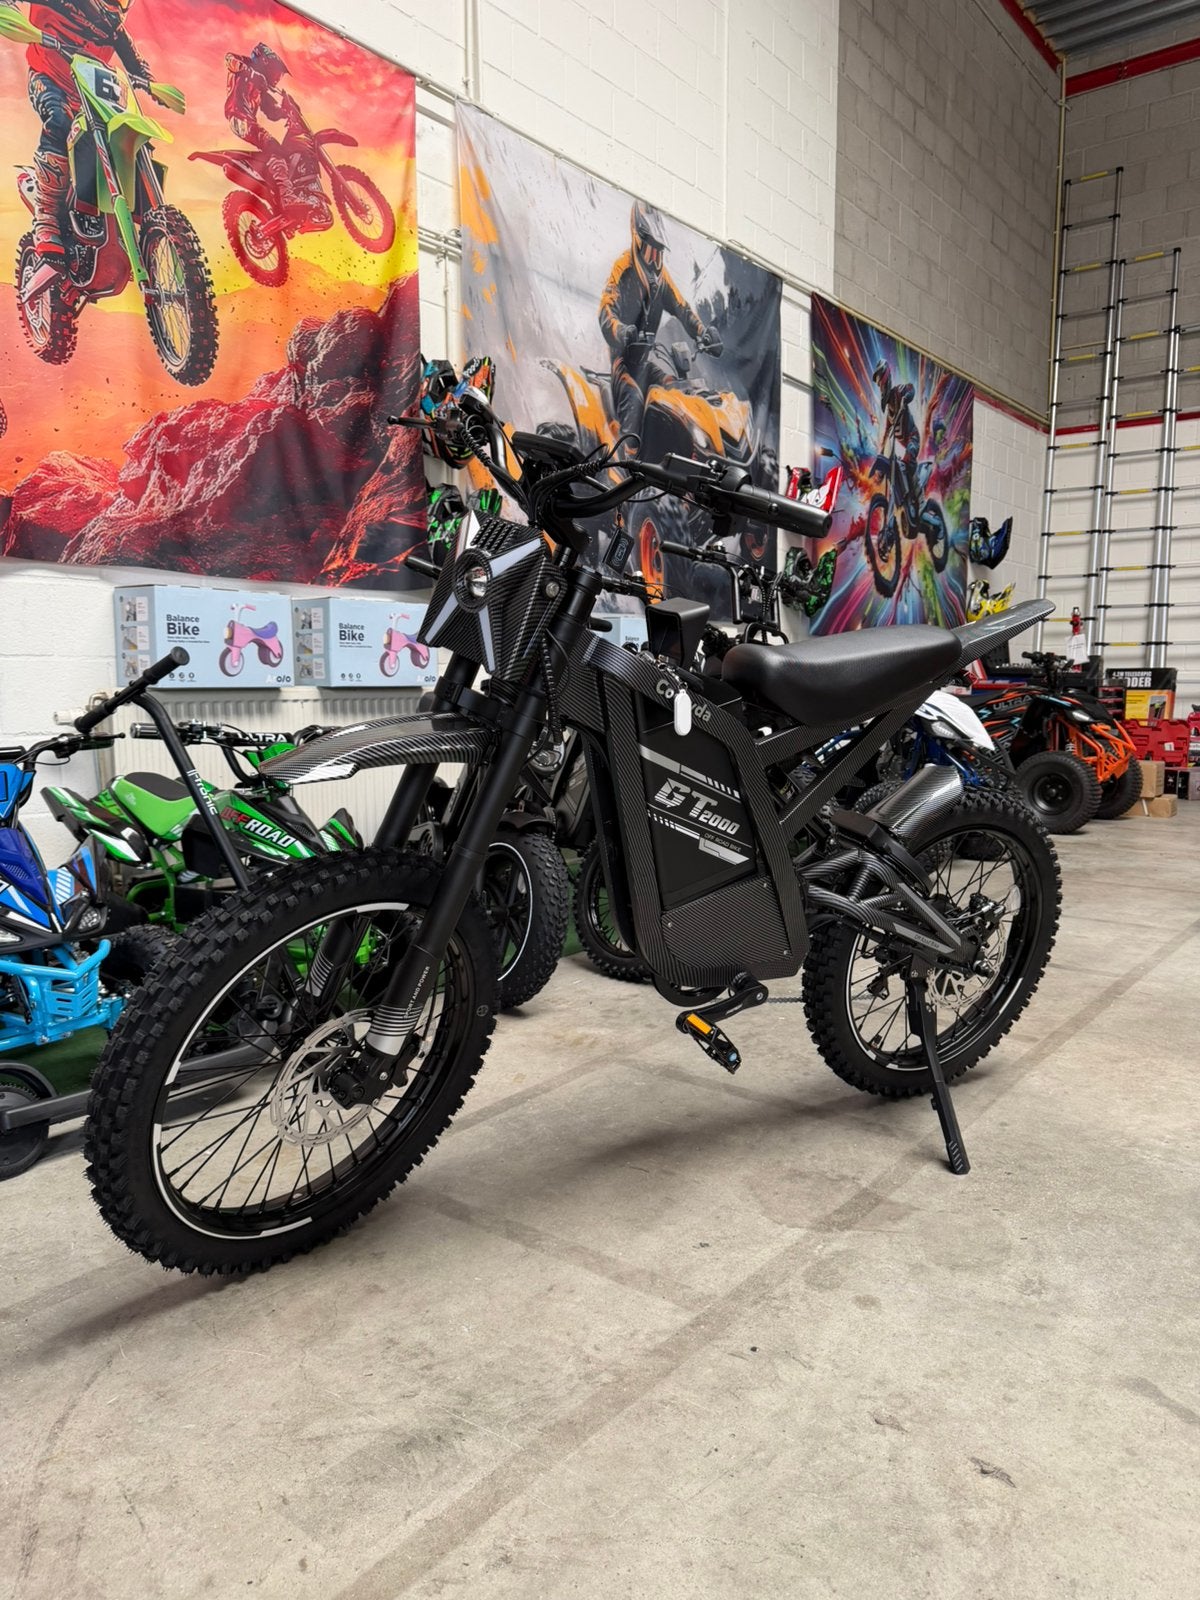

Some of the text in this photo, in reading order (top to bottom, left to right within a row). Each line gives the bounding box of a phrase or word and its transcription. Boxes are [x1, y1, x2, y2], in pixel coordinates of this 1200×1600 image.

[166, 614, 200, 623] Balance
[167, 623, 200, 636] Bike
[339, 622, 365, 630] Balance
[339, 630, 365, 642] Bike
[992, 695, 1032, 711] ULTRA
[220, 806, 297, 848] OFF ROAD
[698, 809, 741, 835] 2000
[418, 966, 430, 988] POWER
